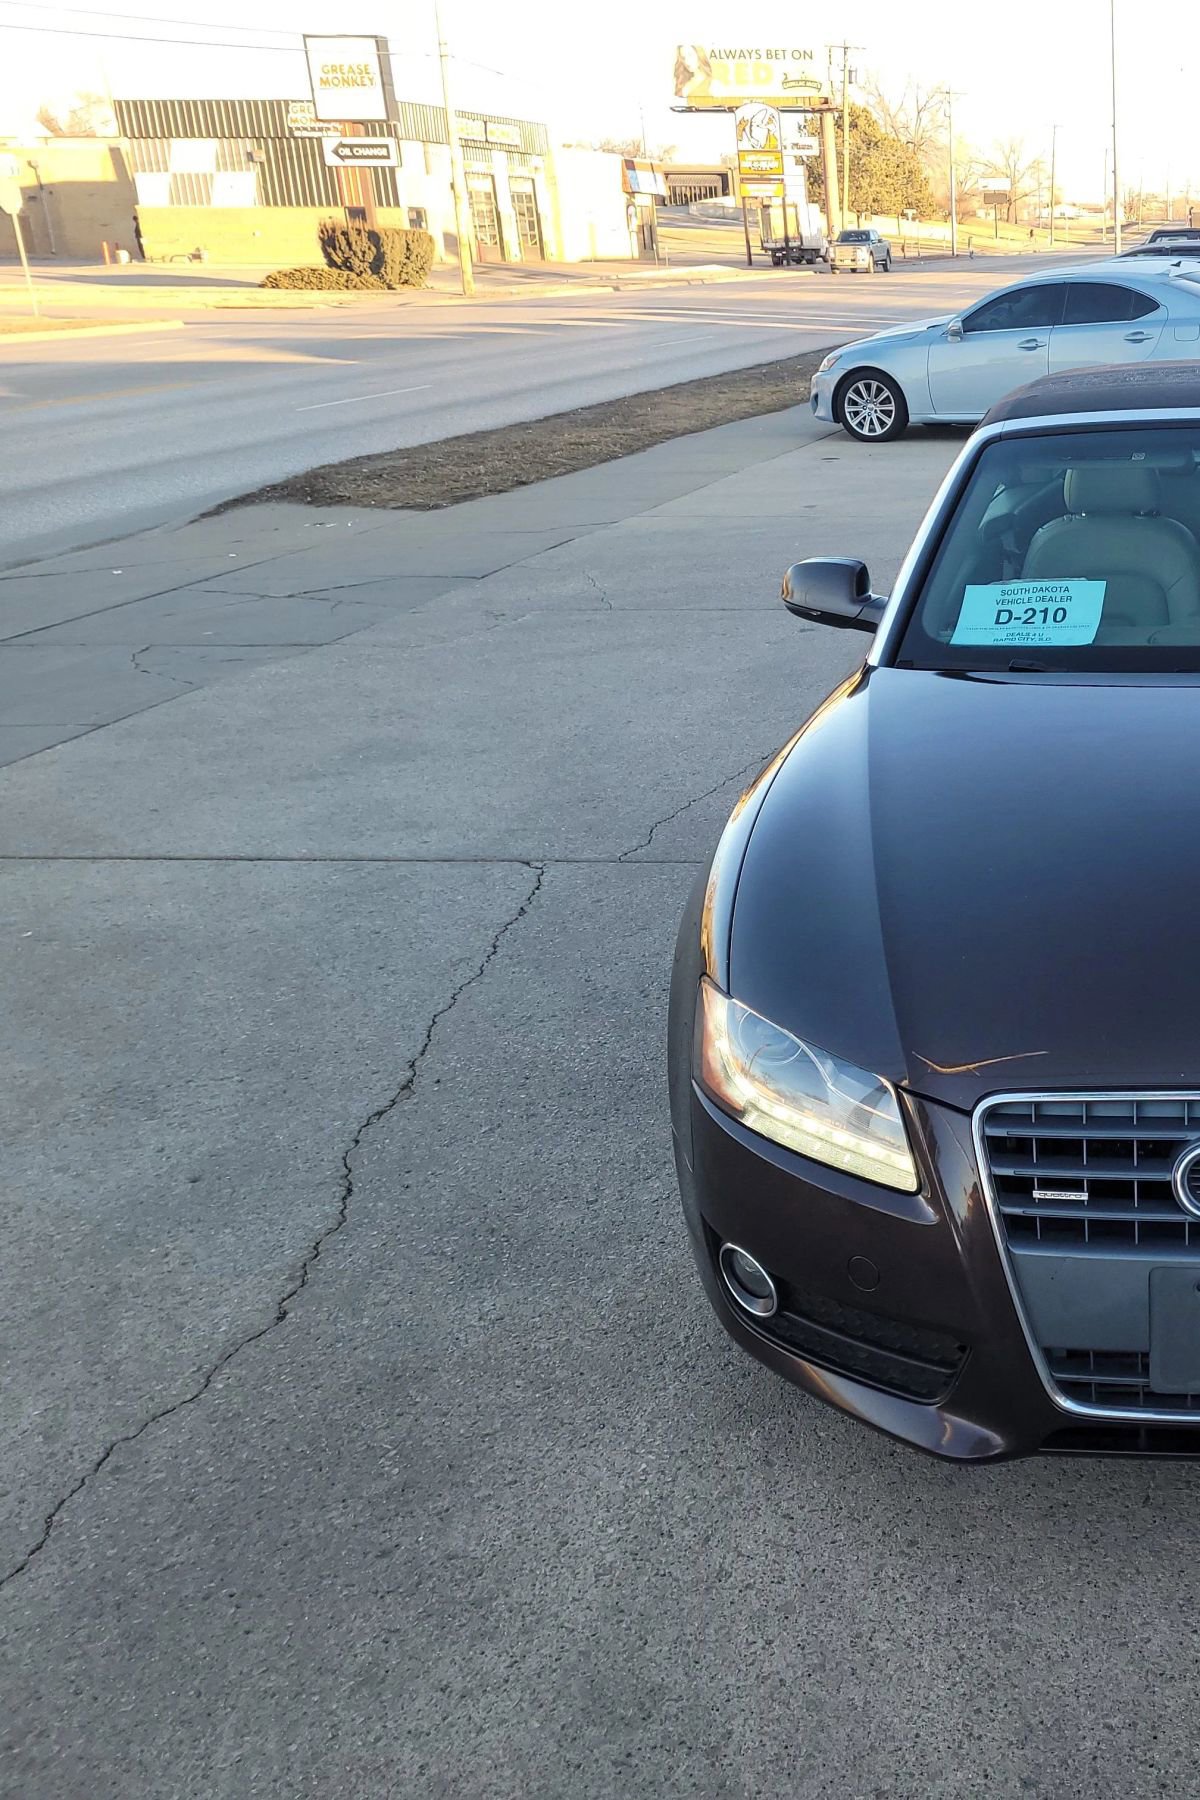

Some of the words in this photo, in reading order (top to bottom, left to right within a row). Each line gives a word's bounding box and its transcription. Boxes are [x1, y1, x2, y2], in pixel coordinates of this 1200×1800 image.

[709, 49, 761, 60] ALWAYS
[766, 49, 787, 60] BET
[791, 49, 813, 60] ON
[321, 64, 371, 75] GREASE
[711, 62, 774, 87] RED
[319, 76, 375, 87] MONKEY
[338, 147, 353, 156] OIL
[352, 147, 389, 156] CHANGE
[1000, 587, 1031, 596] SOUTH
[1032, 585, 1070, 594] DAKOTA
[995, 596, 1033, 606] VEHICLE
[1035, 595, 1073, 603] DEALER
[994, 607, 1067, 625] D-210
